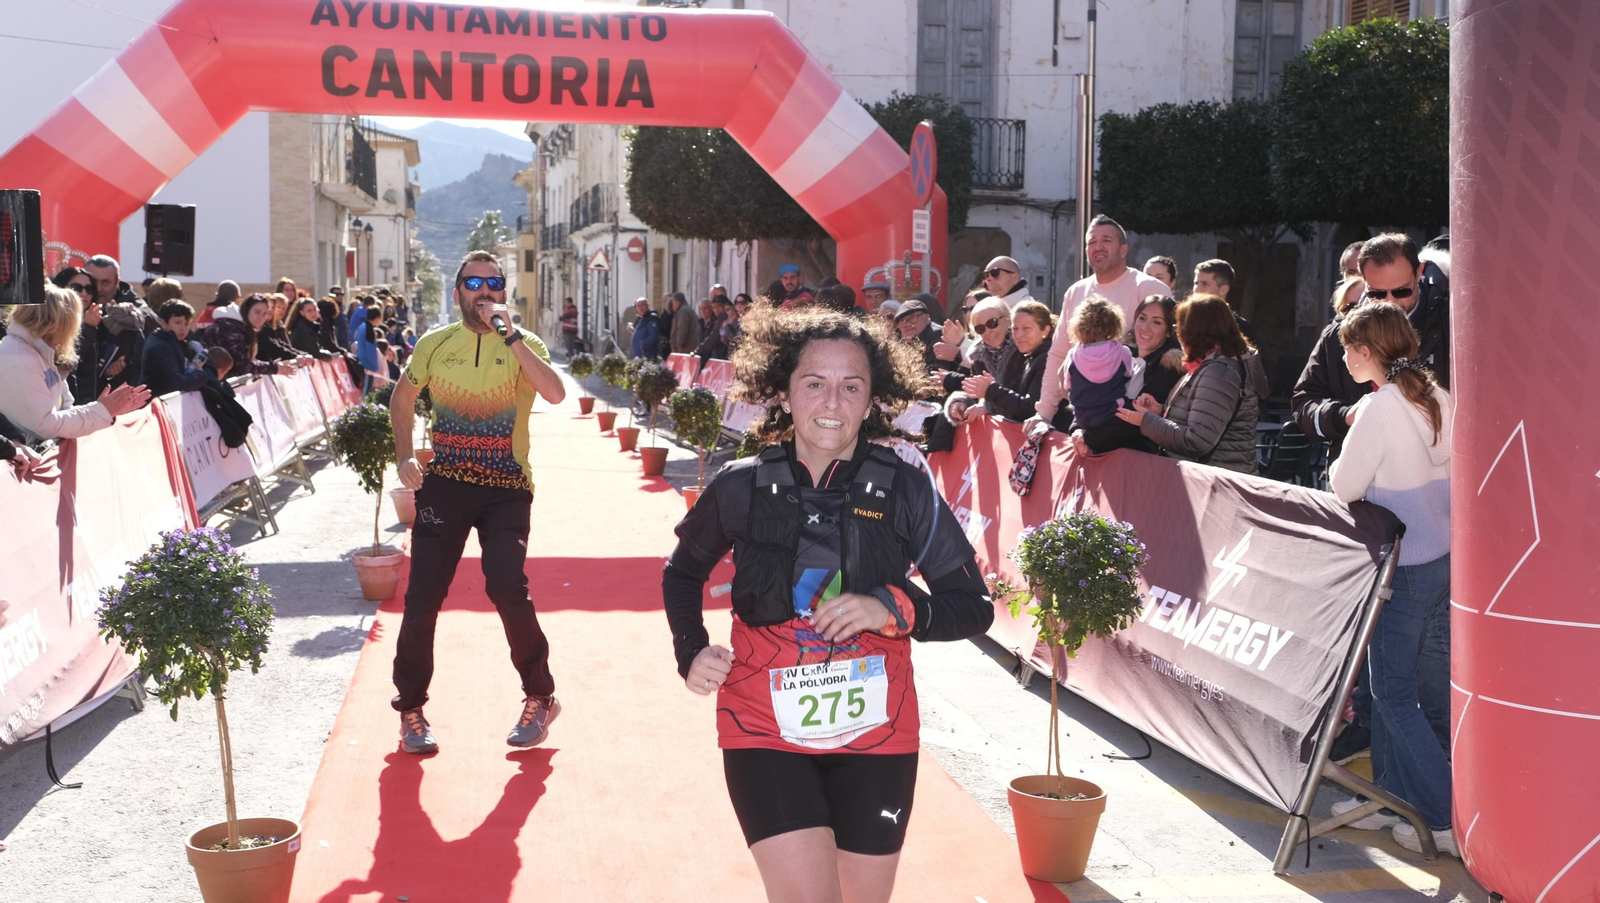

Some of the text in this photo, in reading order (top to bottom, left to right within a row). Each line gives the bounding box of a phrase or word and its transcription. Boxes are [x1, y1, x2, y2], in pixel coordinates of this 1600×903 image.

[310, 0, 668, 42] AYUNTAMIENTO
[320, 44, 656, 109] CANTORIA
[853, 507, 884, 520] EVADICT
[1138, 585, 1295, 672] TEAMERGY
[783, 675, 847, 691] LA PÓLVORA
[1151, 655, 1225, 701] www.teamergy.es
[798, 686, 866, 727] 275
